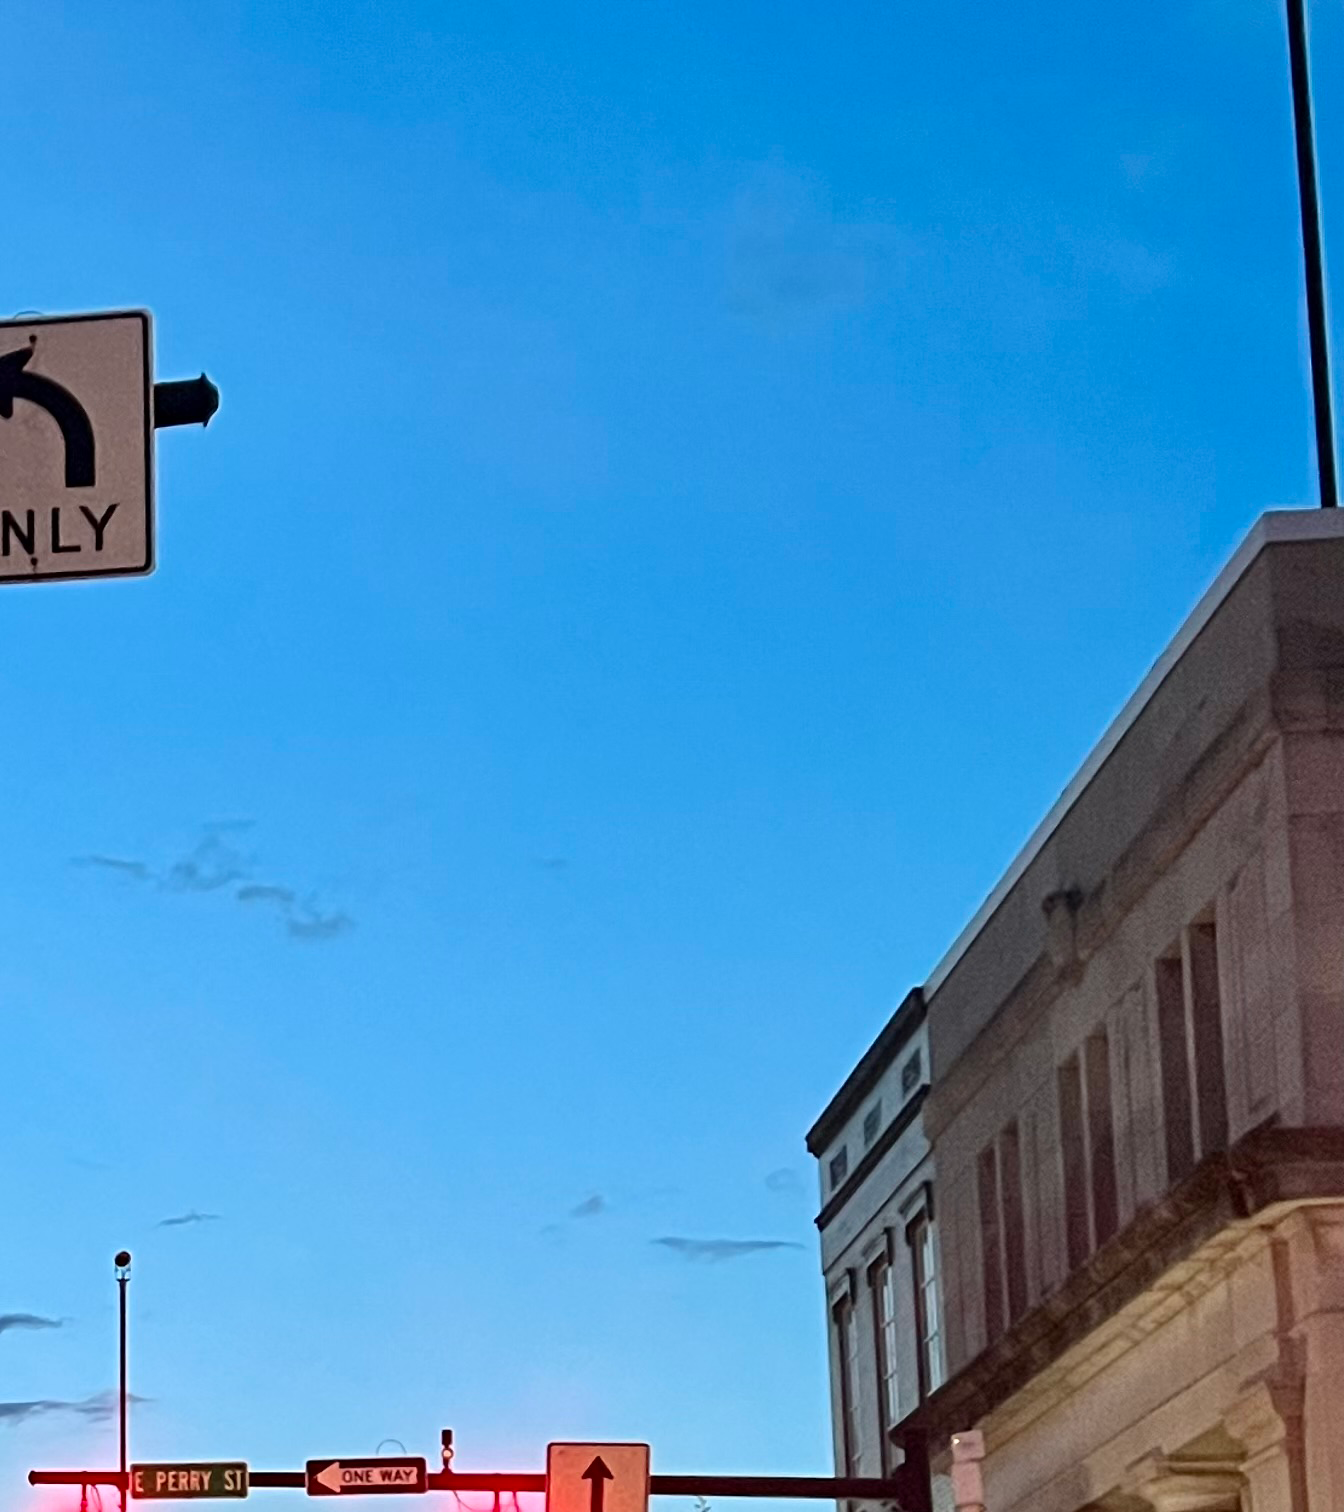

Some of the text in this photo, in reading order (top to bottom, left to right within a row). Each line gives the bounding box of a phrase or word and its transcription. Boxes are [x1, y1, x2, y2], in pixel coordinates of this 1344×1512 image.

[134, 1469, 243, 1492] E PERRY ST
[342, 1468, 414, 1483] ONE WAY
